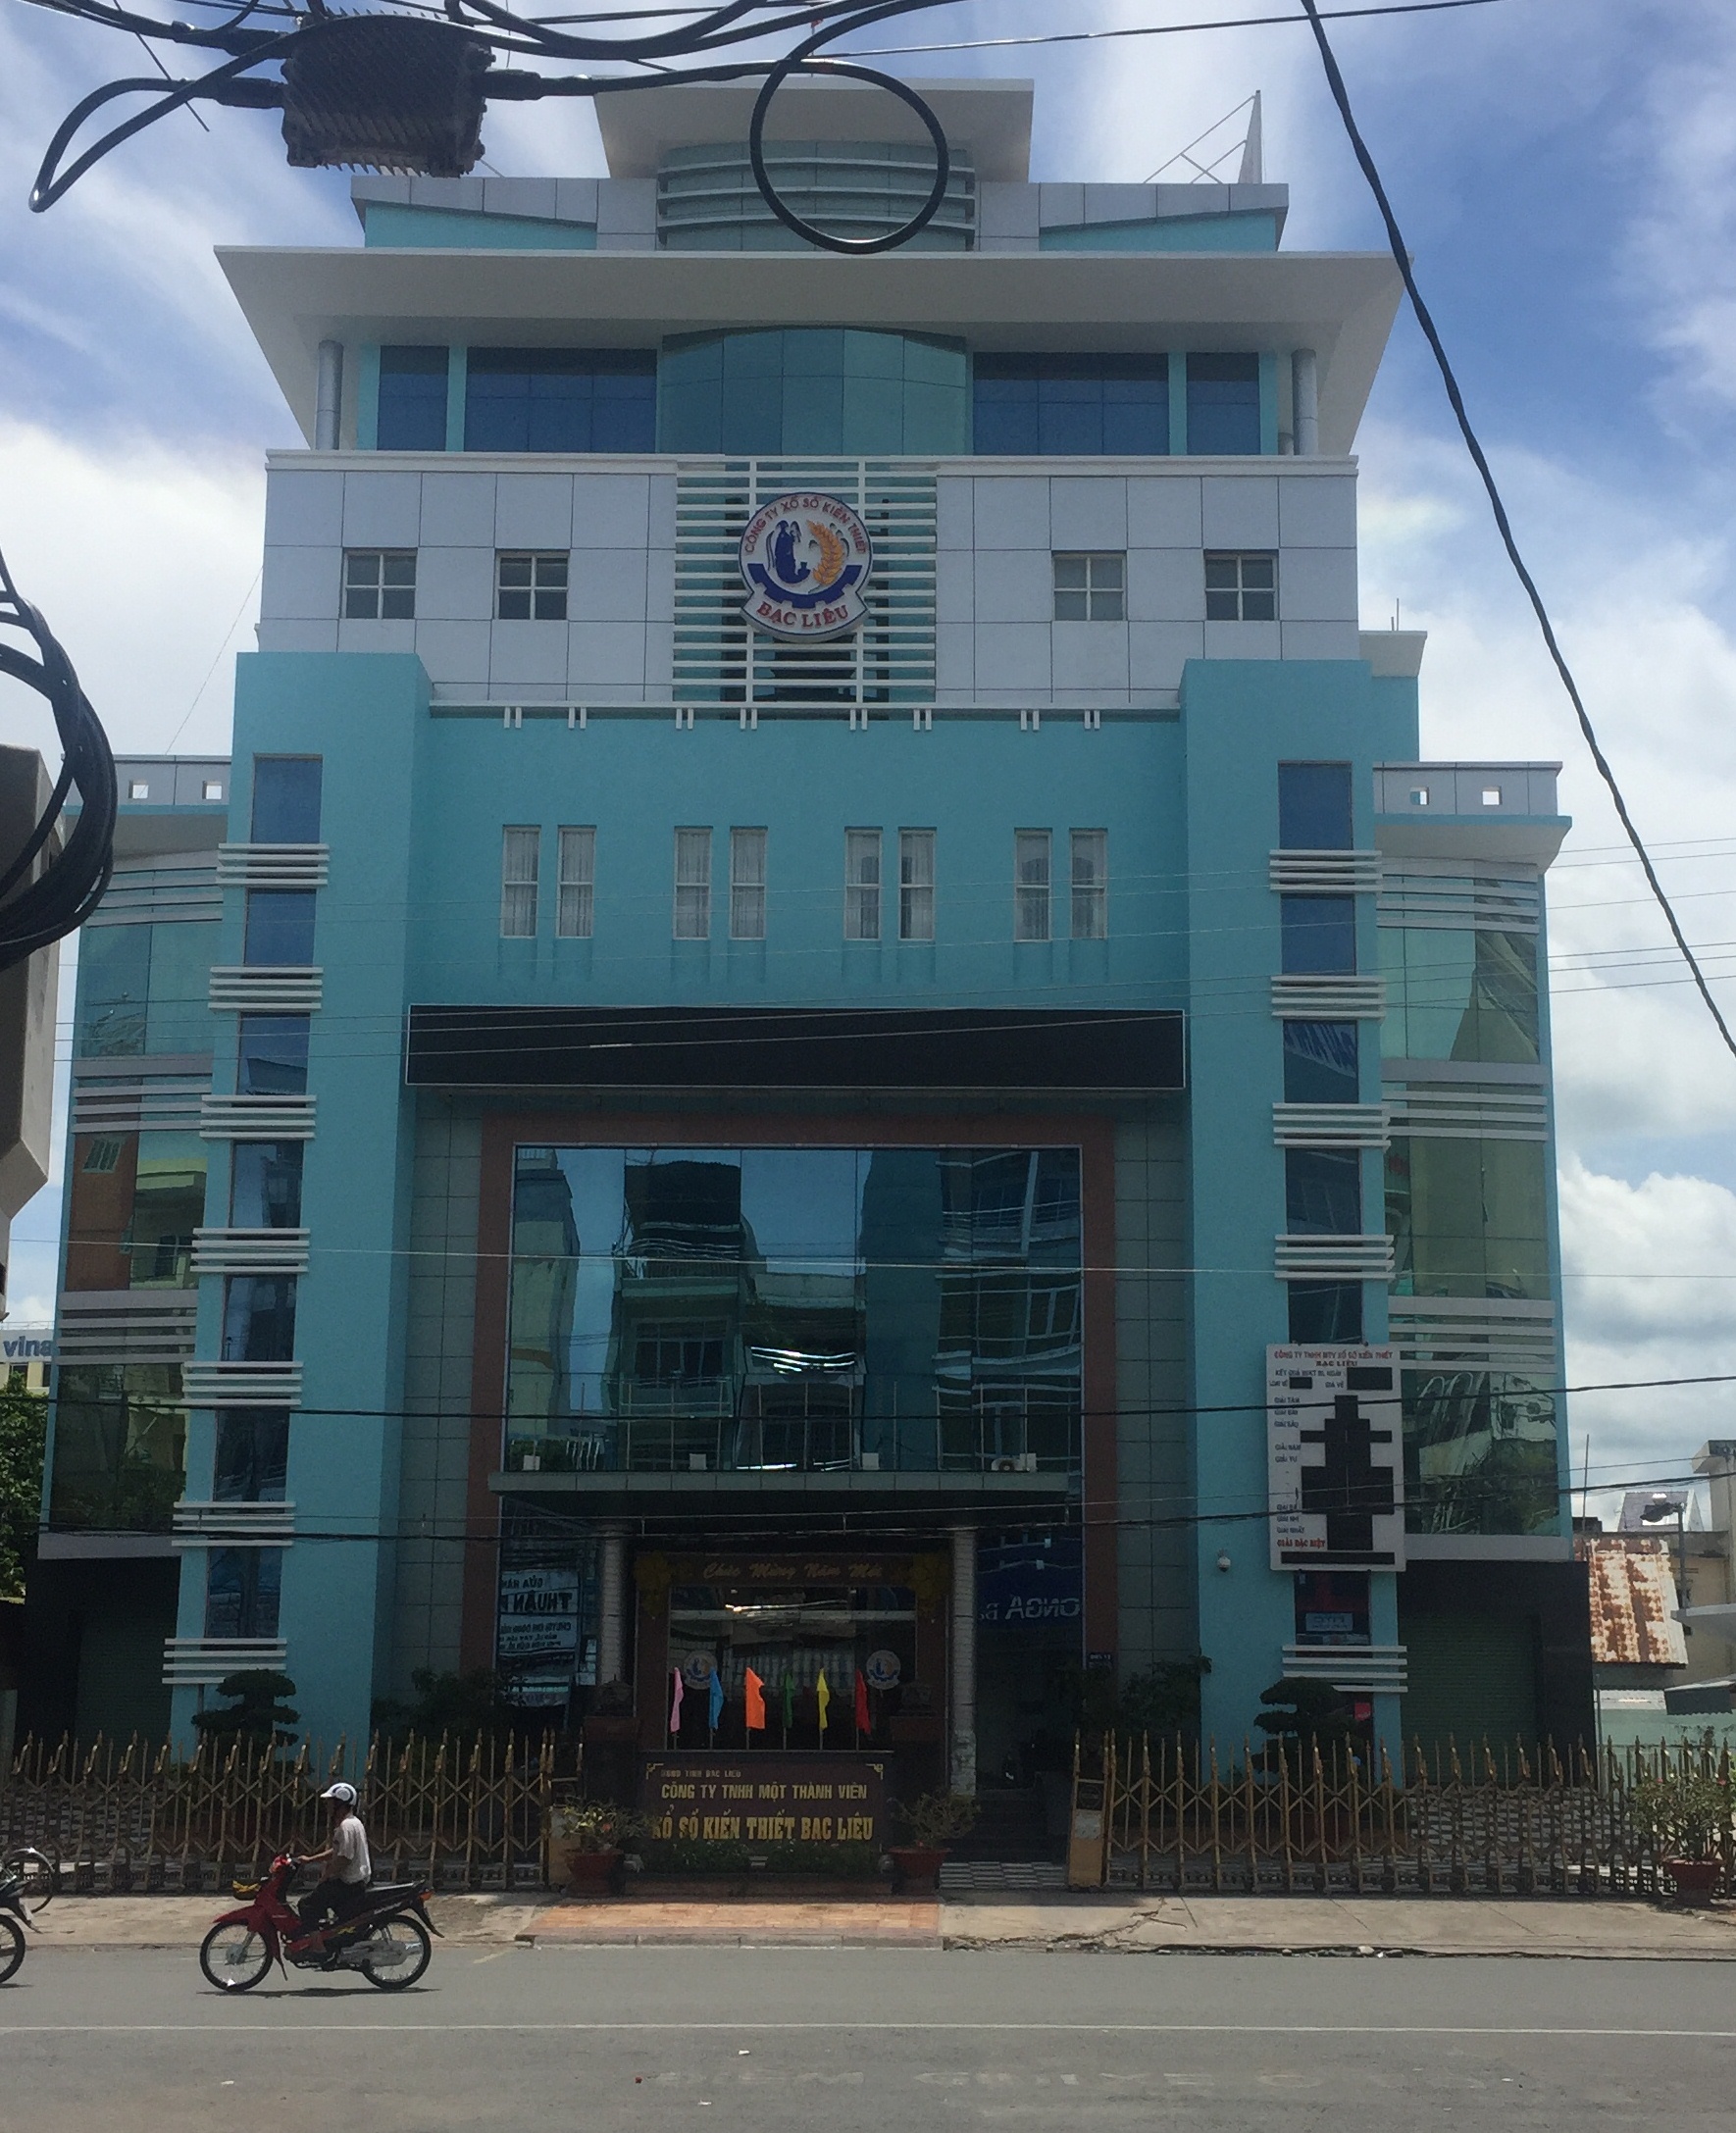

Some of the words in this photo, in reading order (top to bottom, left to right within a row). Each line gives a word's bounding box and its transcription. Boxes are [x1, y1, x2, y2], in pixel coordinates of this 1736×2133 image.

[744, 518, 767, 554] CÔNG
[765, 507, 779, 521] TY
[802, 495, 822, 509] SỐ
[756, 600, 797, 626] BẠC
[801, 604, 849, 628] LIÊU
[661, 1781, 695, 1800] CÔNG
[700, 1784, 717, 1800] TY
[722, 1784, 753, 1800] TNHH
[758, 1781, 787, 1803] MỘT
[792, 1781, 833, 1800] THÀNH
[838, 1781, 868, 1800] VIÊN
[679, 1808, 699, 1841] SỐ
[703, 1808, 740, 1840] KIẾN
[746, 1808, 795, 1840] THIẾT
[837, 1811, 874, 1841] LIÊU
